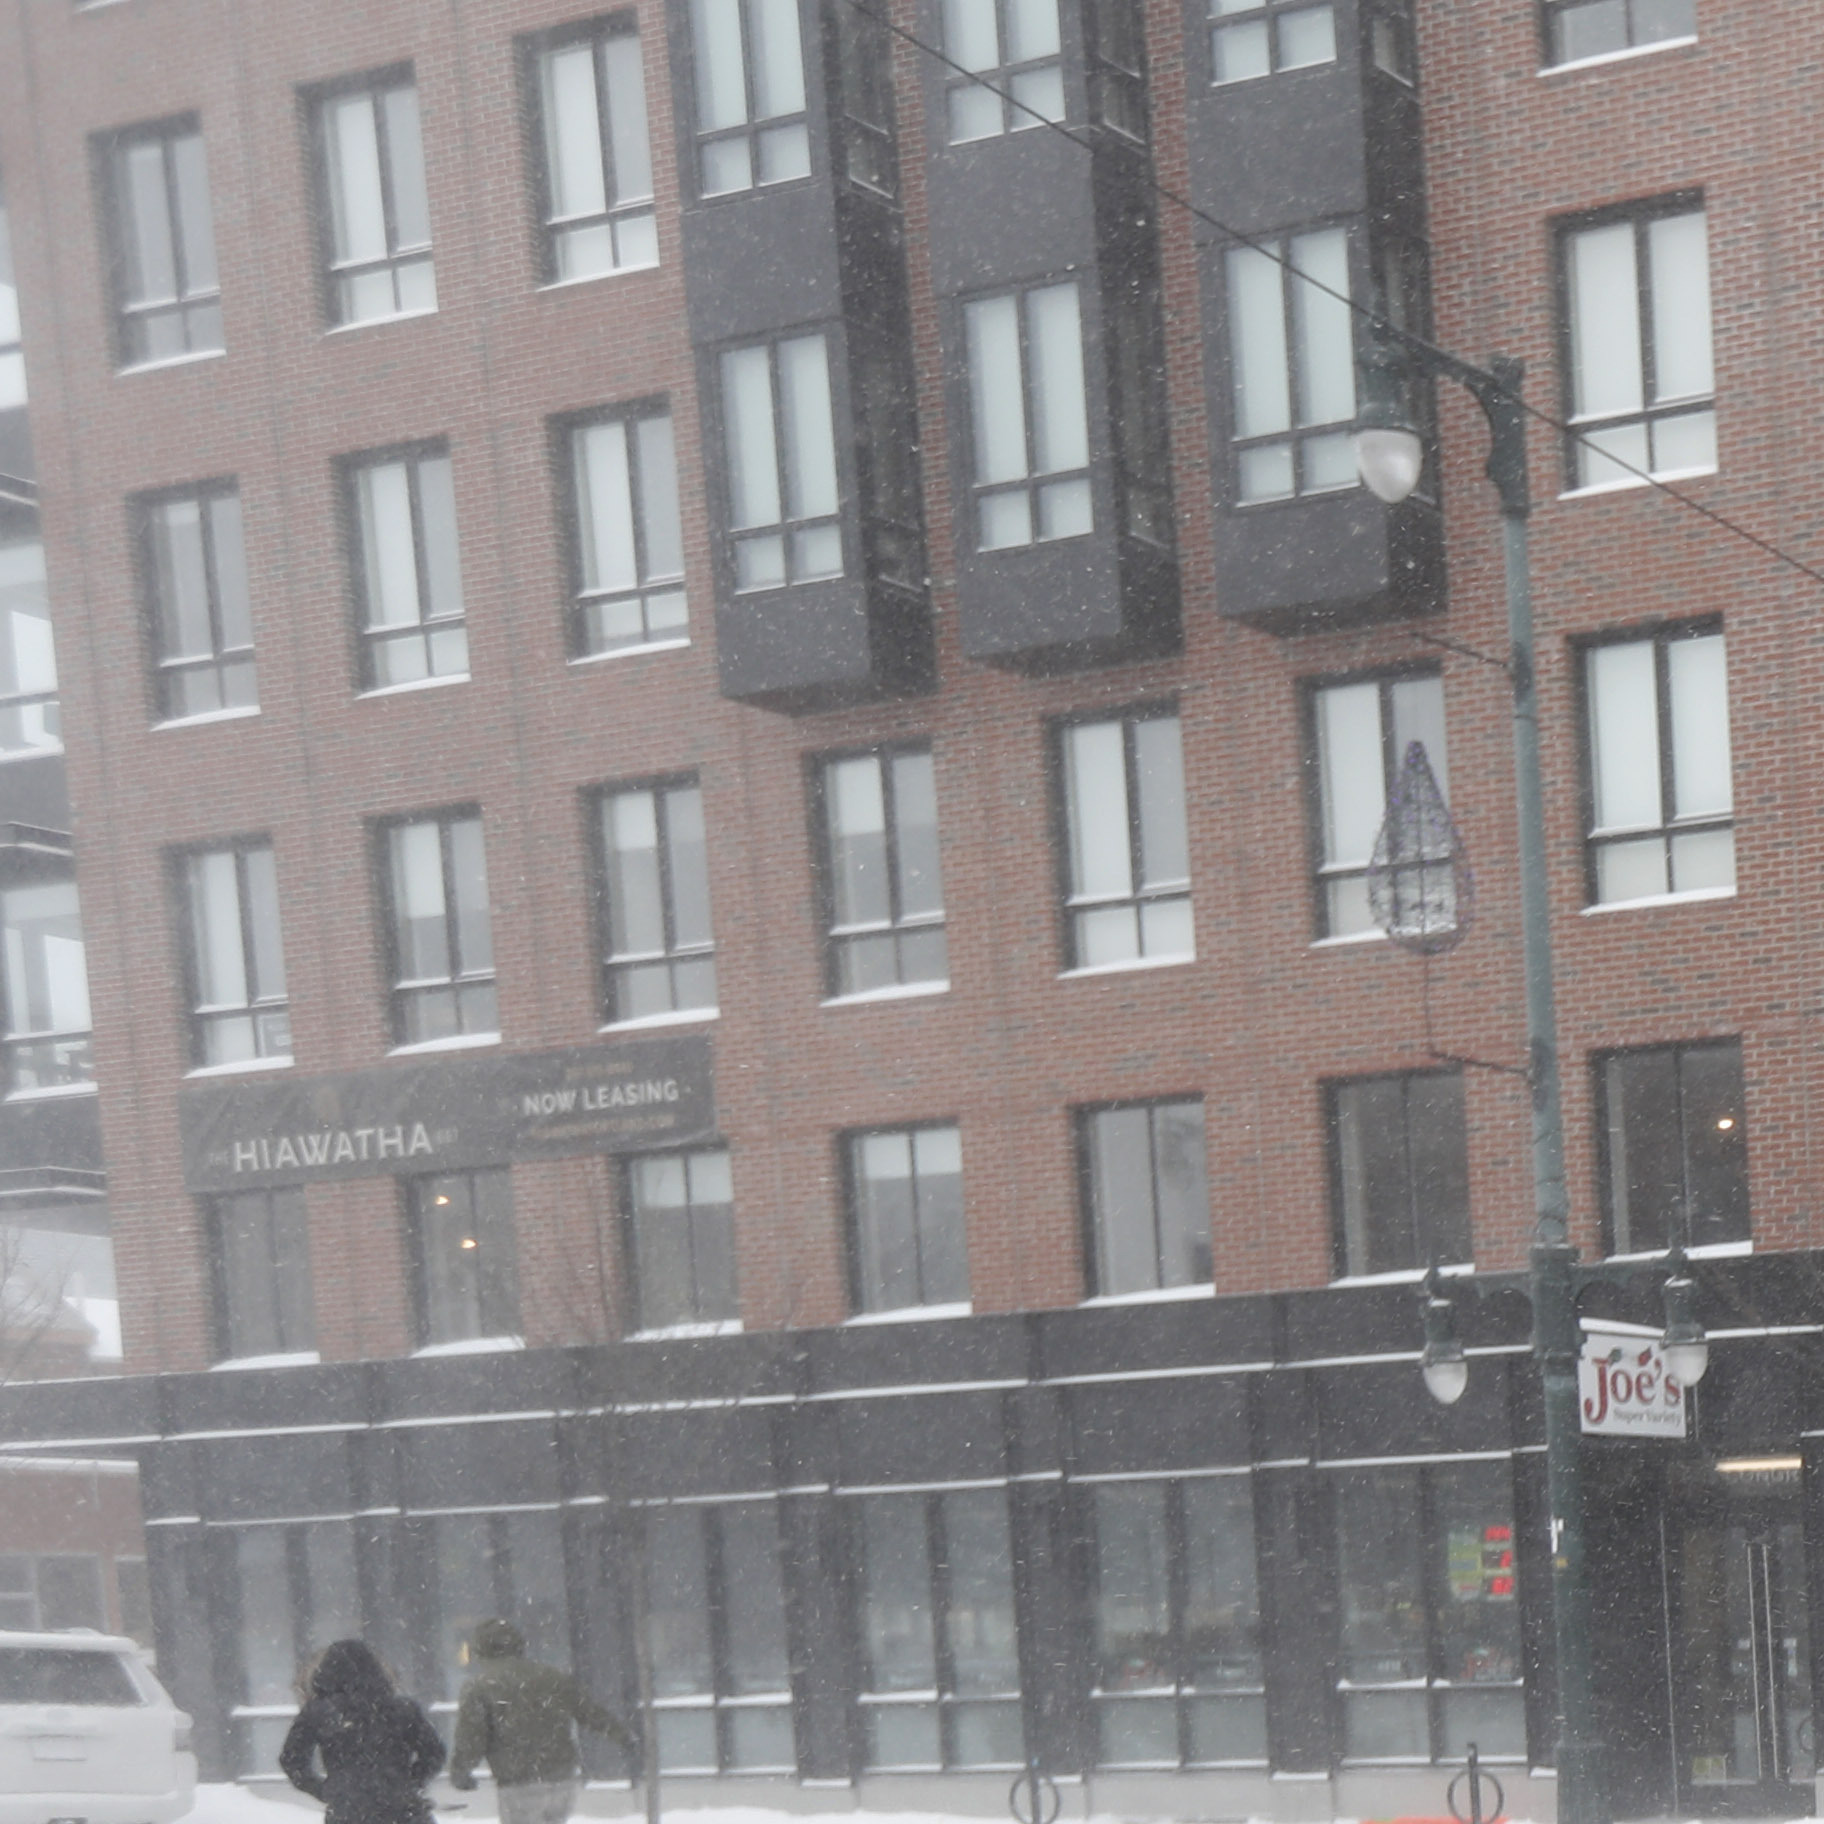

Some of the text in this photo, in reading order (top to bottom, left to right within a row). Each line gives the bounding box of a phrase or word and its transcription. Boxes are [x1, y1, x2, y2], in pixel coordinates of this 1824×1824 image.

[524, 1078, 680, 1116] NOW LEASING
[234, 1121, 433, 1173] HIAWATHA
[1583, 1355, 1682, 1424] Joe's
